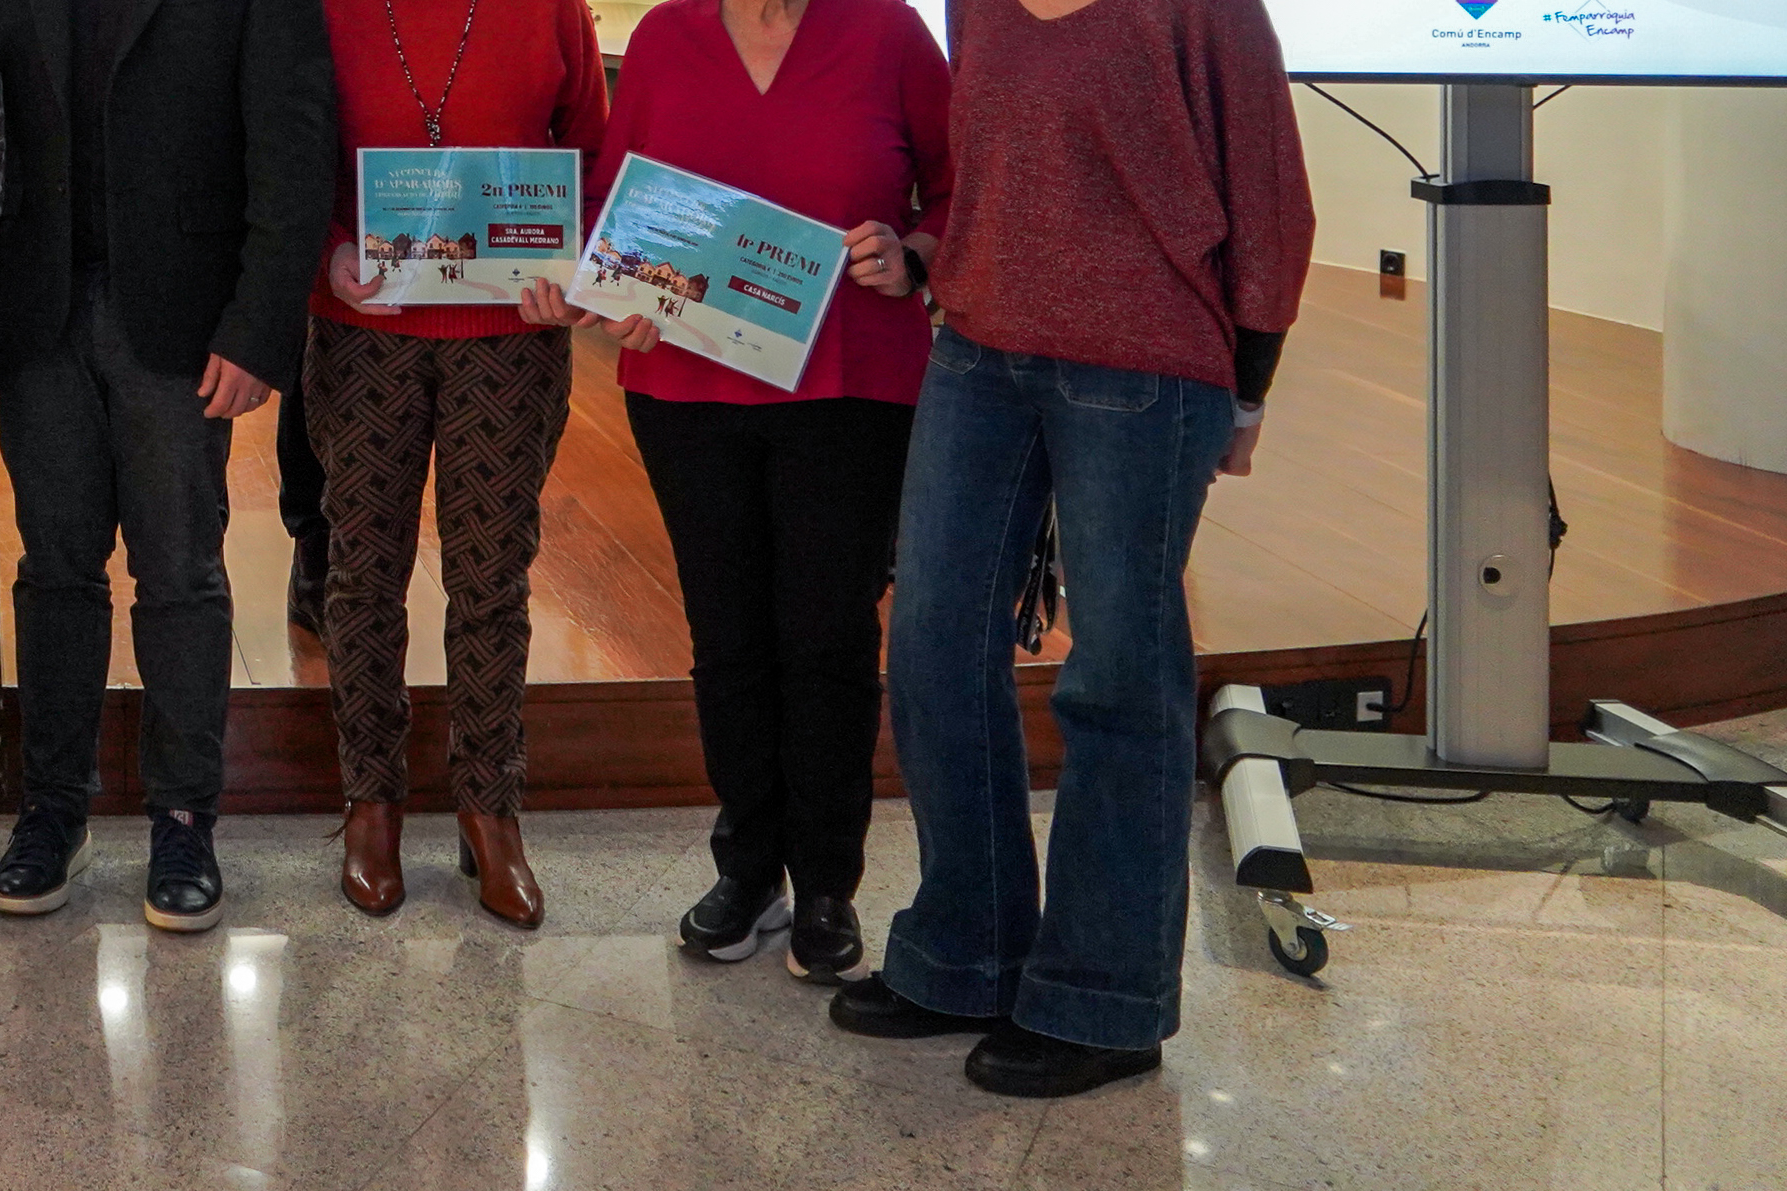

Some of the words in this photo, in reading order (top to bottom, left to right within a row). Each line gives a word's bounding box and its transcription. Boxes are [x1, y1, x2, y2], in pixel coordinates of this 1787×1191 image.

[1432, 29, 1464, 39] Comú
[1586, 24, 1634, 38] Encamp
[481, 183, 502, 197] 2n
[508, 184, 567, 198] PREMI
[491, 236, 528, 244] CASADEVALL
[737, 233, 754, 248] 1r
[757, 240, 821, 276] PREMI
[743, 284, 762, 297] CASA
[762, 291, 786, 306] NARCÍS
